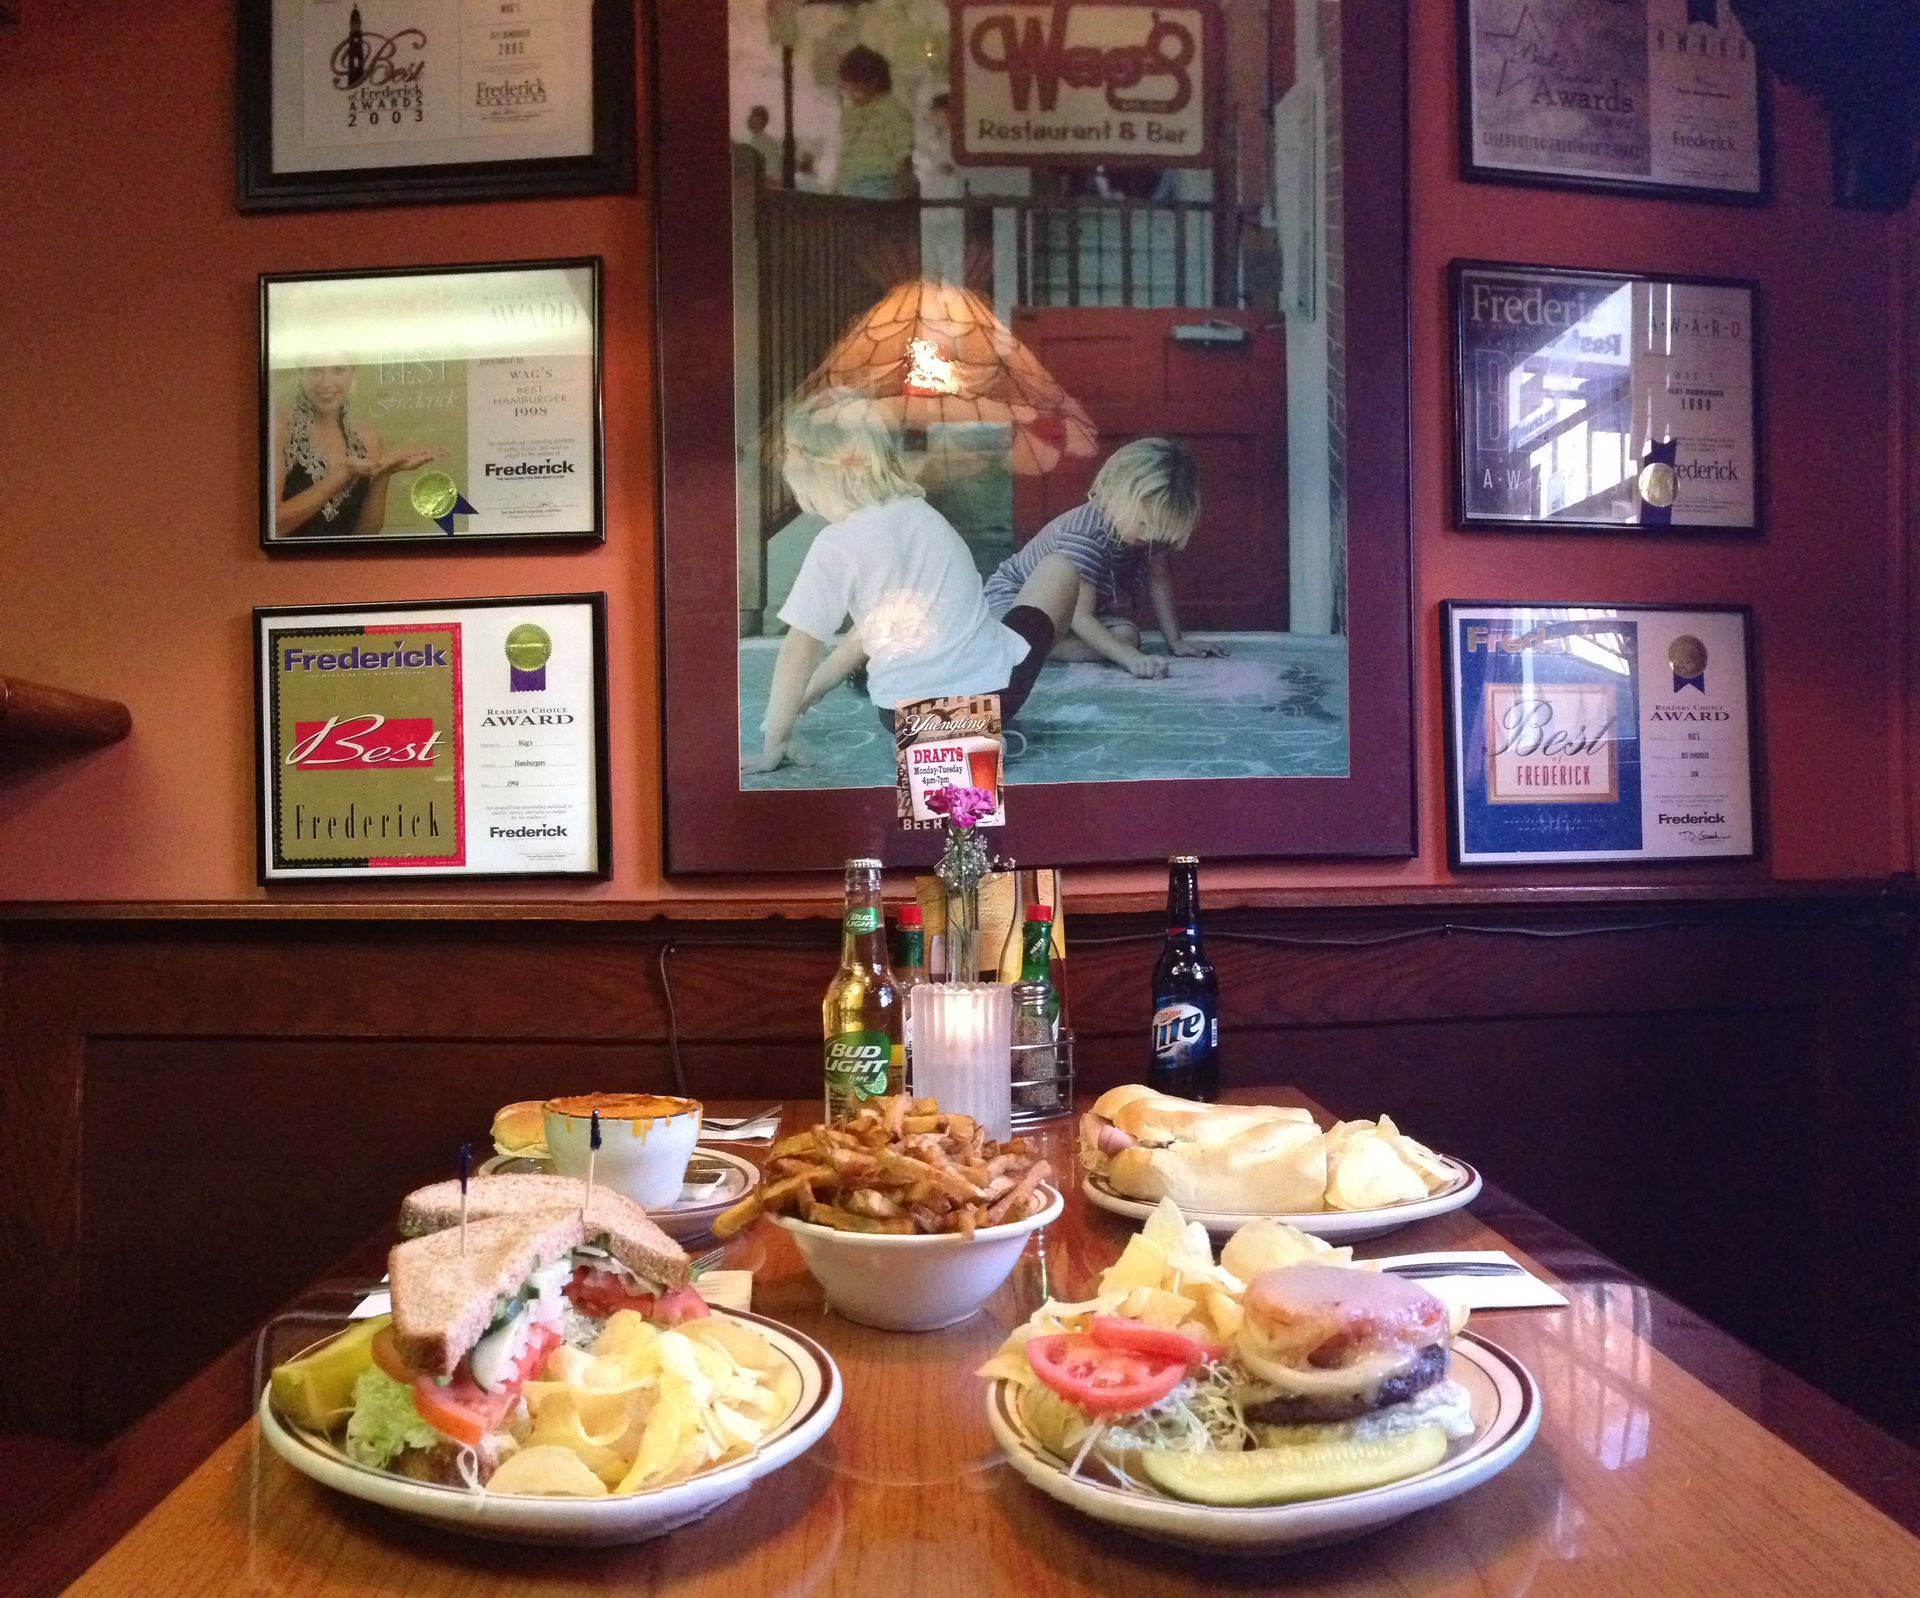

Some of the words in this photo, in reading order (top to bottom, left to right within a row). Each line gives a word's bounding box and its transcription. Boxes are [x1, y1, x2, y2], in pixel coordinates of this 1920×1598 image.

[330, 28, 427, 91] Best
[476, 79, 546, 98] Frederick
[1530, 75, 1635, 113] Awards
[349, 96, 423, 111] AWARDS
[348, 109, 424, 128] 2003
[978, 119, 1112, 141] Restaurant
[1118, 121, 1137, 141] &
[1146, 121, 1188, 144] Bar
[1672, 131, 1736, 151] Frederick
[1471, 284, 1597, 327] Frederi
[493, 394, 567, 405] HAMBURGER
[514, 406, 548, 417] 1998
[485, 458, 575, 477] Frederick
[284, 640, 449, 673] Frederick
[487, 708, 528, 716] READERS
[531, 706, 568, 714] CHOICE
[1650, 711, 1730, 721] AWARD
[480, 715, 575, 728] AWARD
[903, 714, 992, 736] Yuengling
[1486, 699, 1617, 757] Best
[285, 713, 446, 765] Best
[913, 747, 964, 764] DRAFTS
[913, 765, 963, 776] Monday-Tuesday
[1516, 765, 1591, 786] FREDERICK
[922, 776, 950, 786] 4pm-7pm
[295, 801, 441, 840] Frederick
[903, 818, 943, 831] BEER
[1658, 811, 1726, 824] Frederick
[489, 824, 568, 838] Frederick
[847, 920, 877, 928] LIGHT
[850, 913, 875, 923] BUD
[831, 1043, 882, 1059] BUD
[825, 1056, 889, 1073] LIGHT
